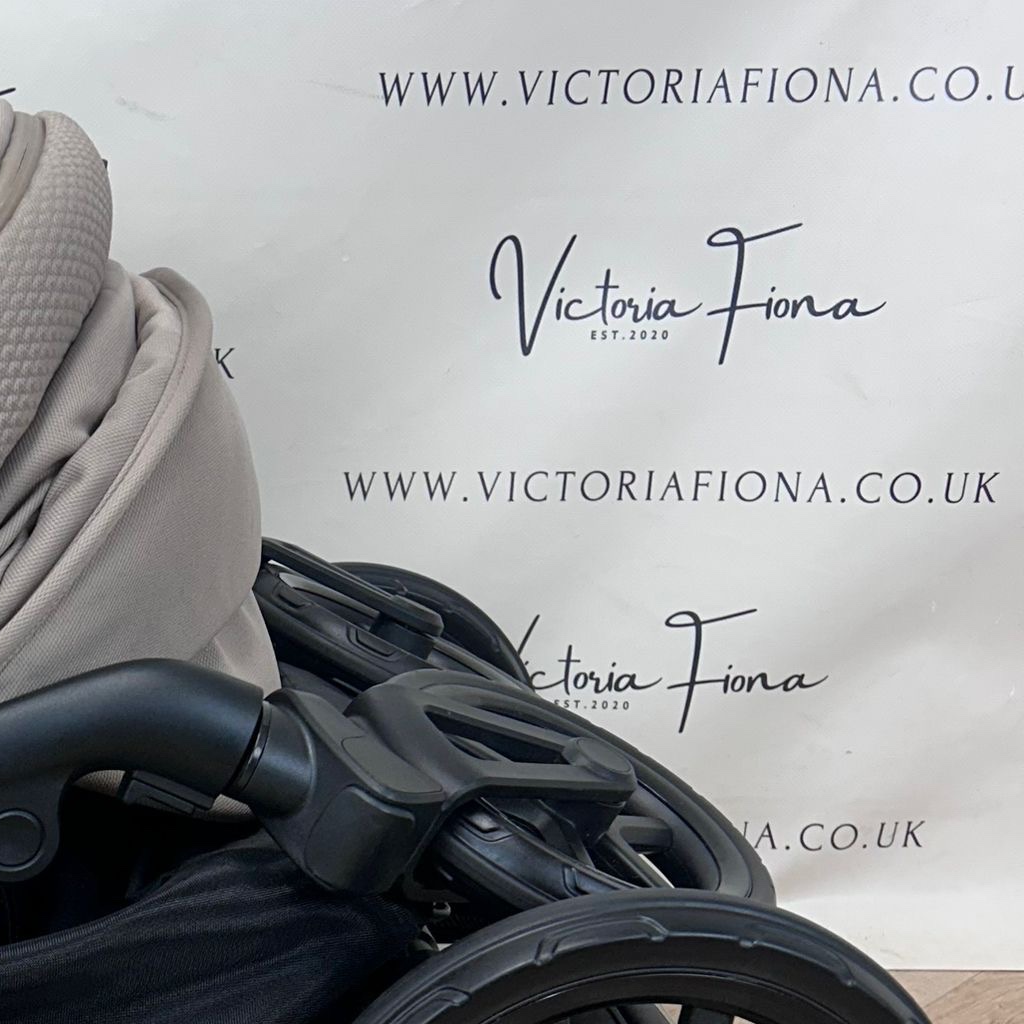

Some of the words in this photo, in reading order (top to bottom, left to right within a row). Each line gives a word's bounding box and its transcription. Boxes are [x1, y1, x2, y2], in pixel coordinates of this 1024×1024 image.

[489, 234, 703, 356] Victoria
[707, 223, 887, 365] Fiona
[591, 330, 668, 340] EST.2020
[343, 470, 1000, 504] WWW.VICTORIAFIONA.CO.UK
[518, 614, 662, 697] ctoria
[665, 609, 829, 734] Fiona
[744, 821, 925, 851] A.CO.UK
